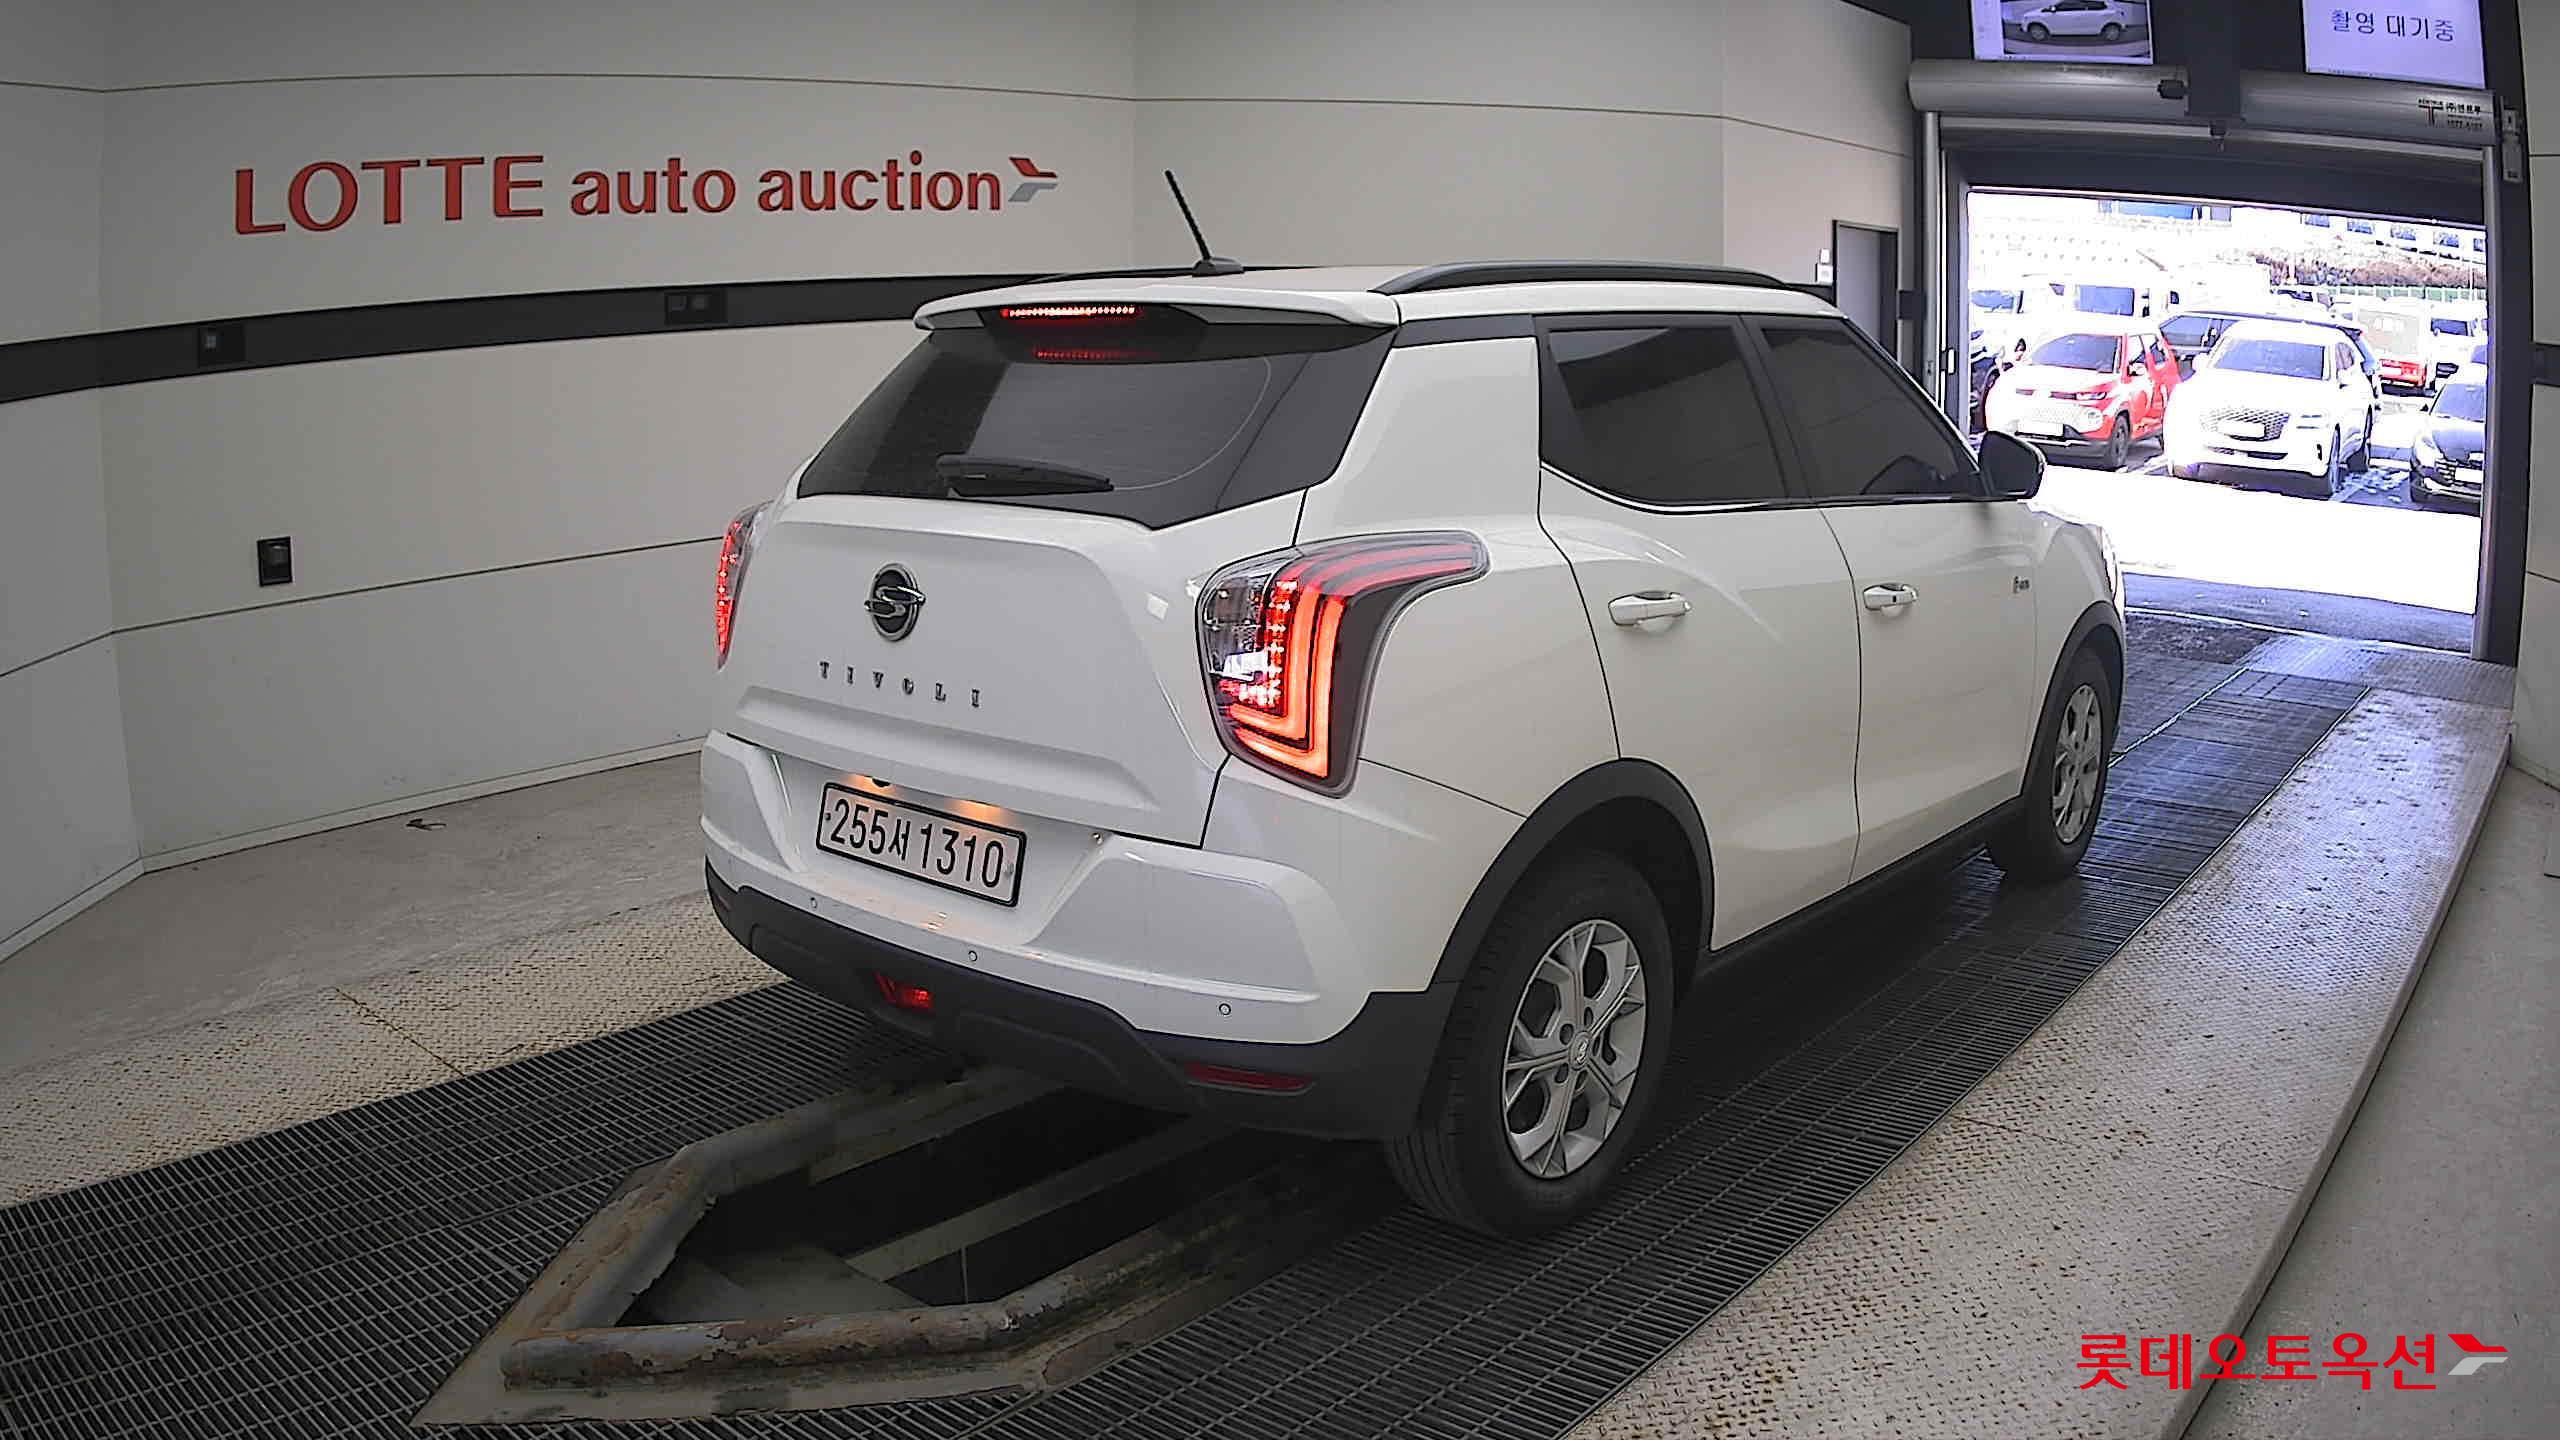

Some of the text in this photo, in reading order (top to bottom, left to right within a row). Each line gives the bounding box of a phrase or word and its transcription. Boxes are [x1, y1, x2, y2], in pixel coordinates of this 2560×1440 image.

[2331, 9, 2454, 43] 촬영 대기중
[235, 150, 1001, 235] LOTTE auto auction
[819, 661, 980, 708] TIVOLI
